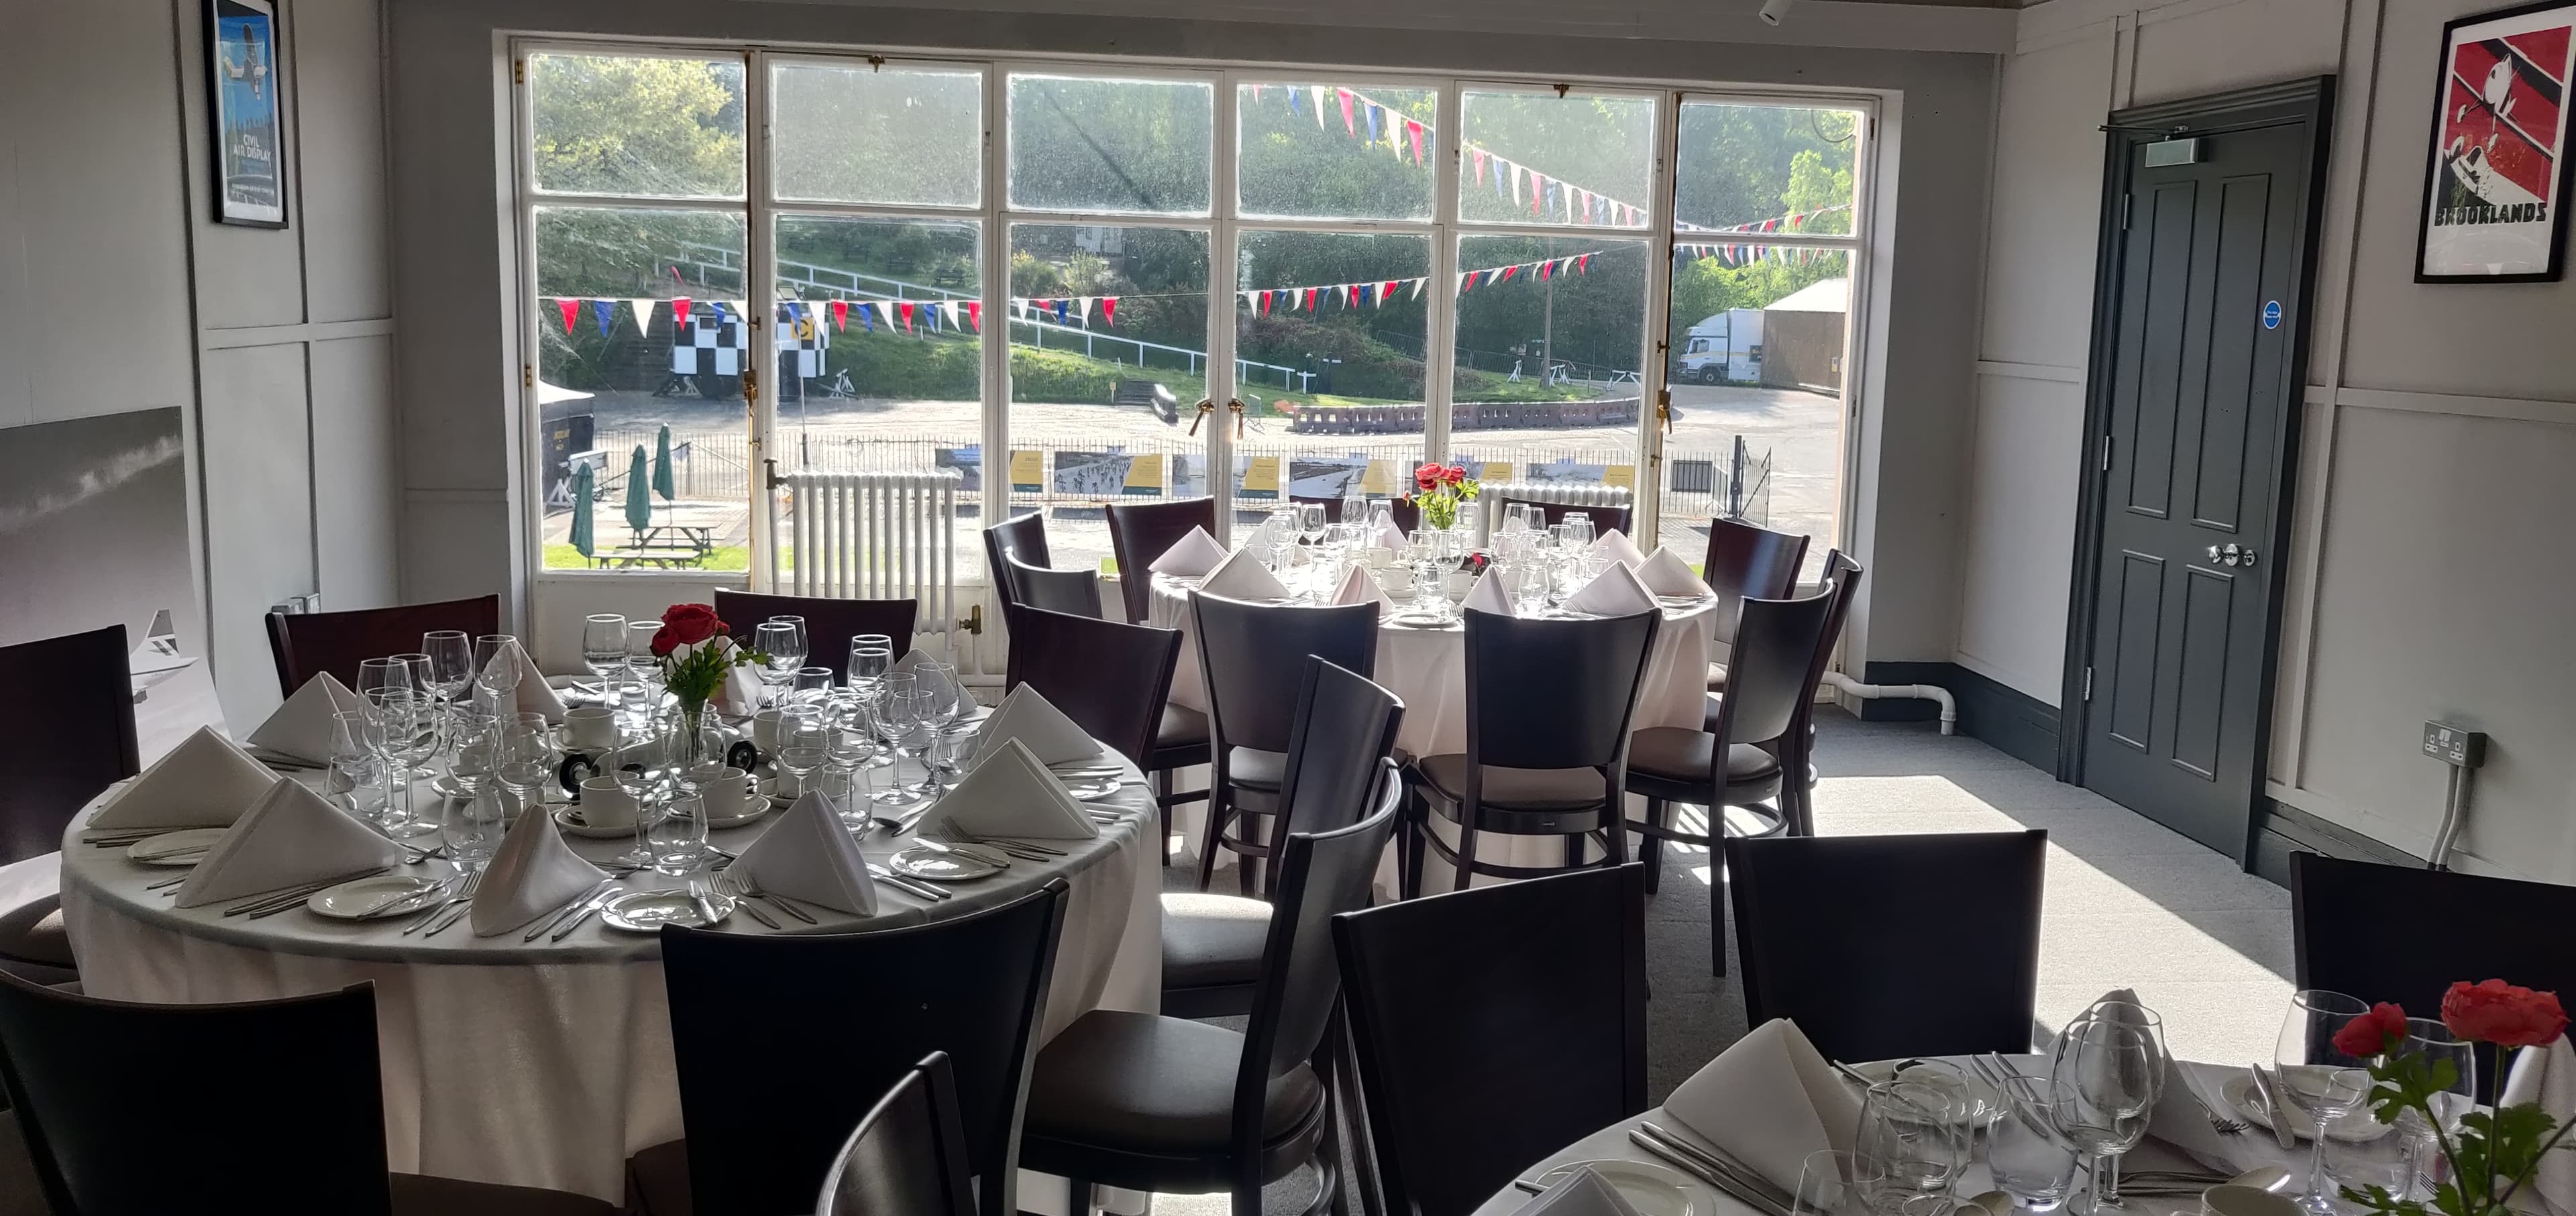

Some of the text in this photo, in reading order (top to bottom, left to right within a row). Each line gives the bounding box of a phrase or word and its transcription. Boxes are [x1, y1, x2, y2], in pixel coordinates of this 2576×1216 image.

[243, 133, 260, 148] CIVIL
[233, 144, 271, 162] AIR DISPLAY
[2434, 203, 2548, 226] BROOKLANDS
